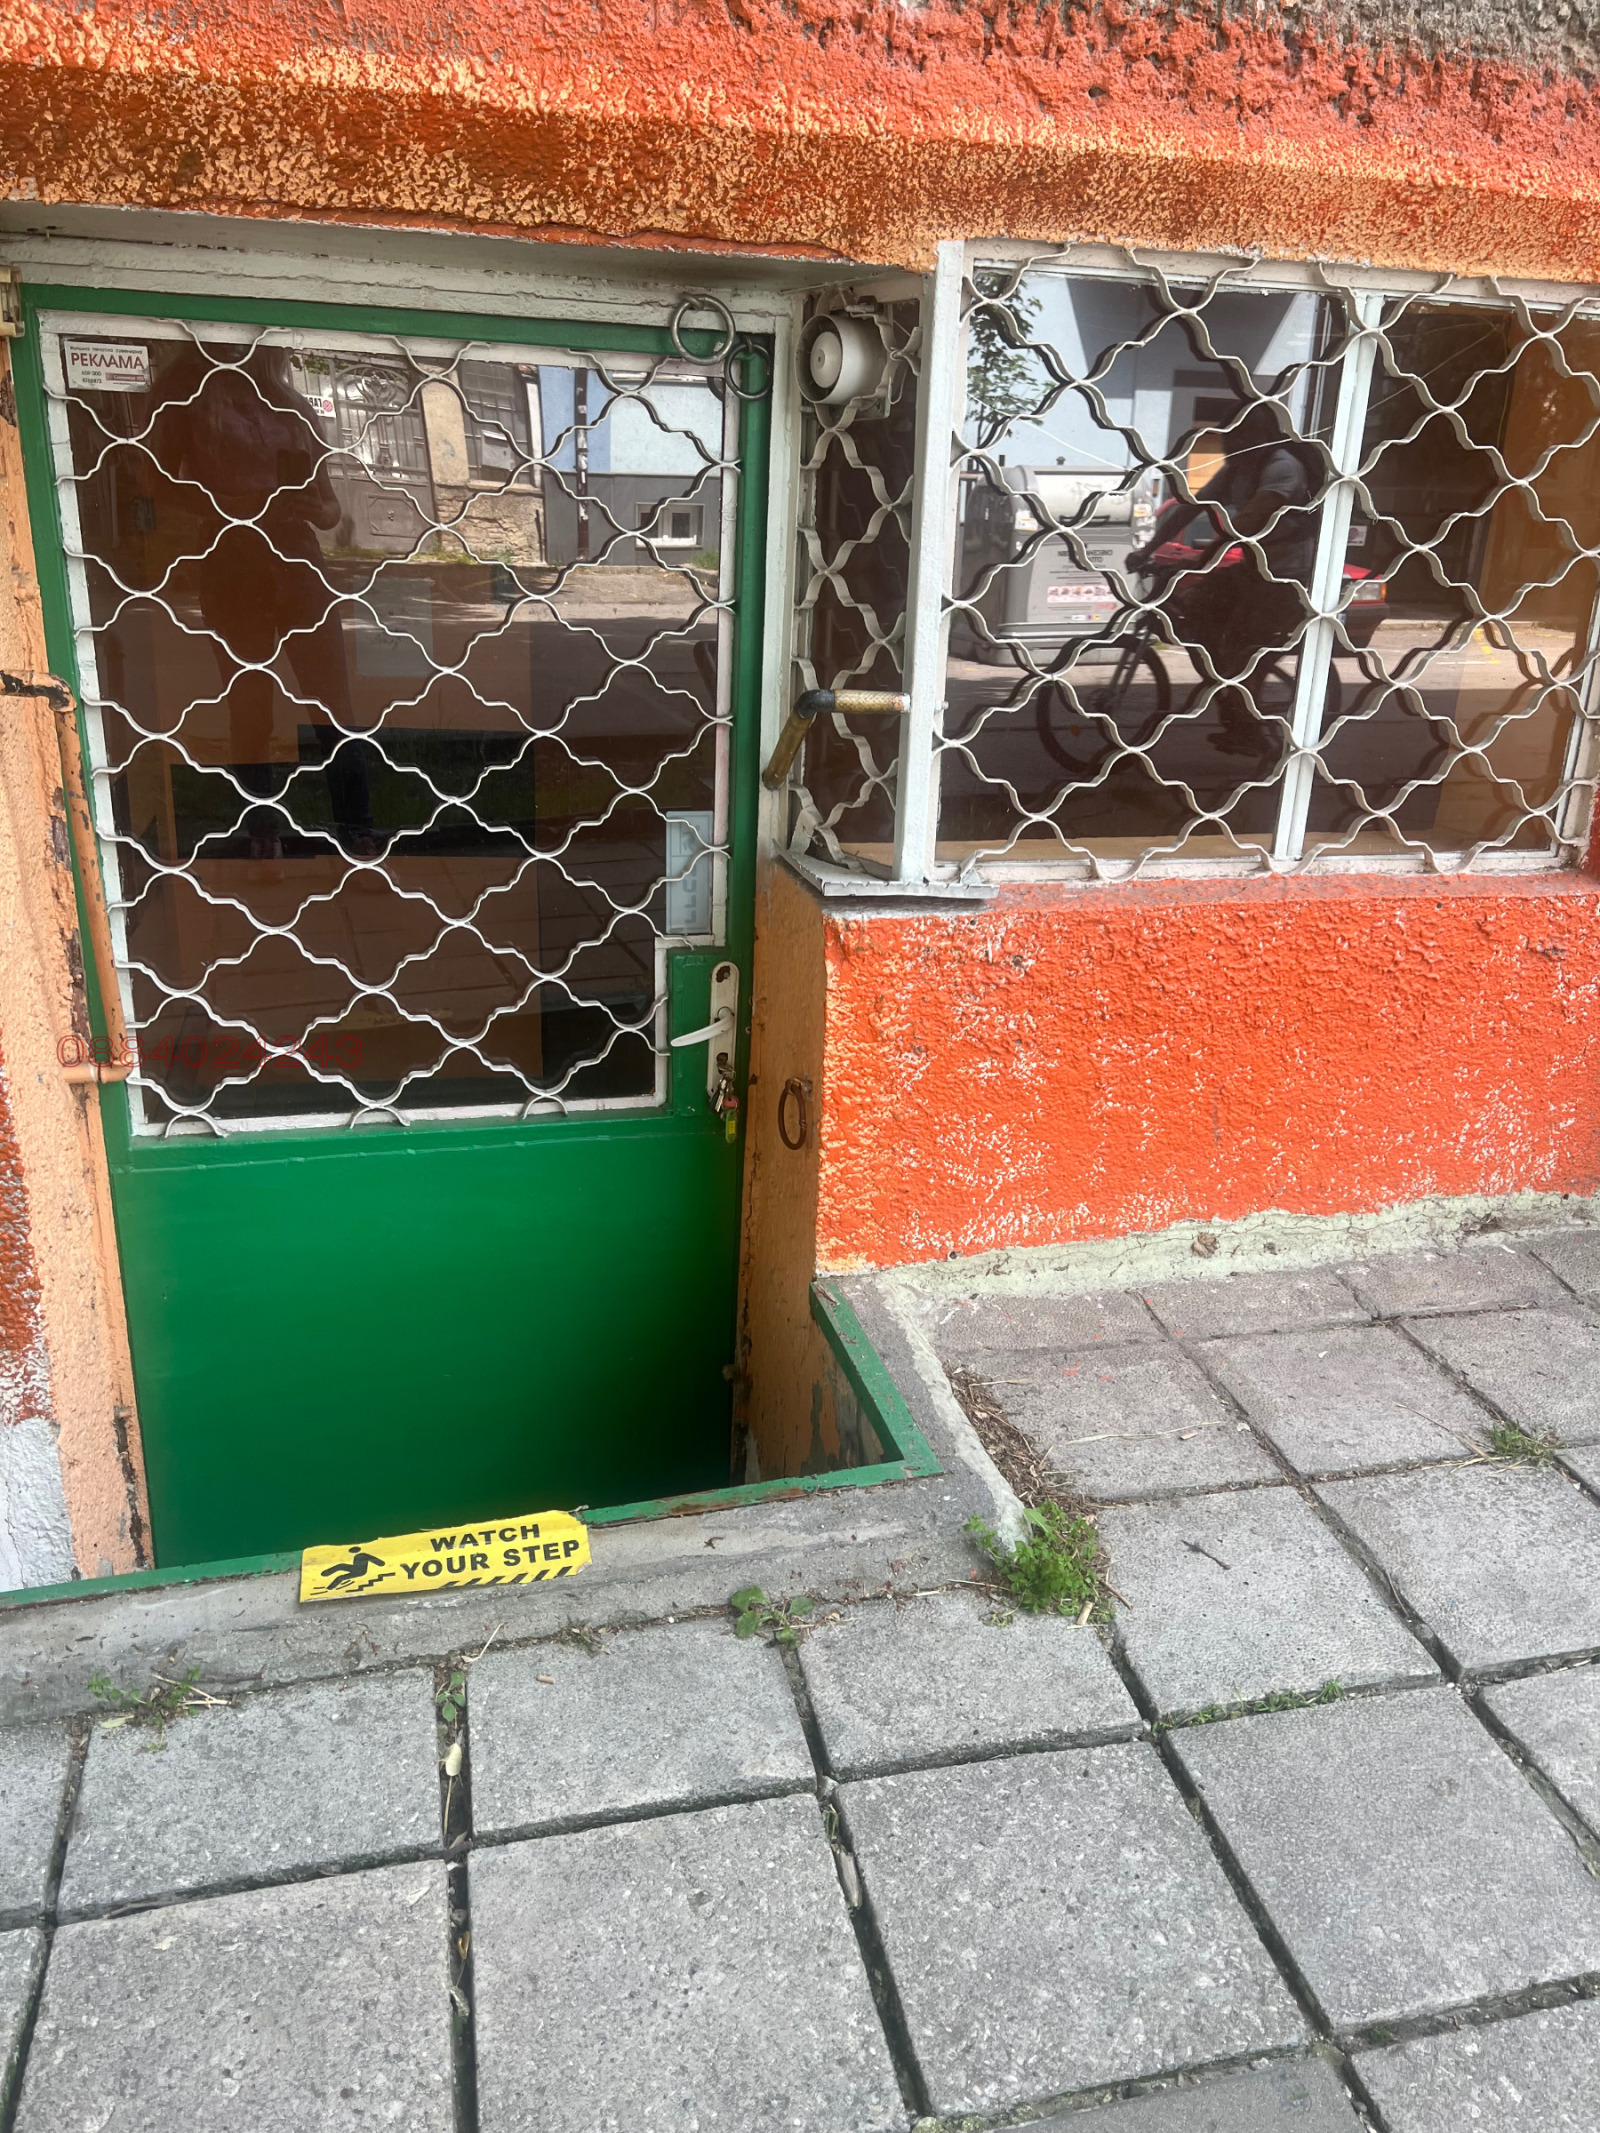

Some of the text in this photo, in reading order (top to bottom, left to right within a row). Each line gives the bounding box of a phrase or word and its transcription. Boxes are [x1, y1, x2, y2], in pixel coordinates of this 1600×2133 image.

[71, 352, 145, 370] РЕКЛАМА
[430, 1523, 541, 1552] WATCH
[400, 1539, 580, 1580] YOUR STEP
